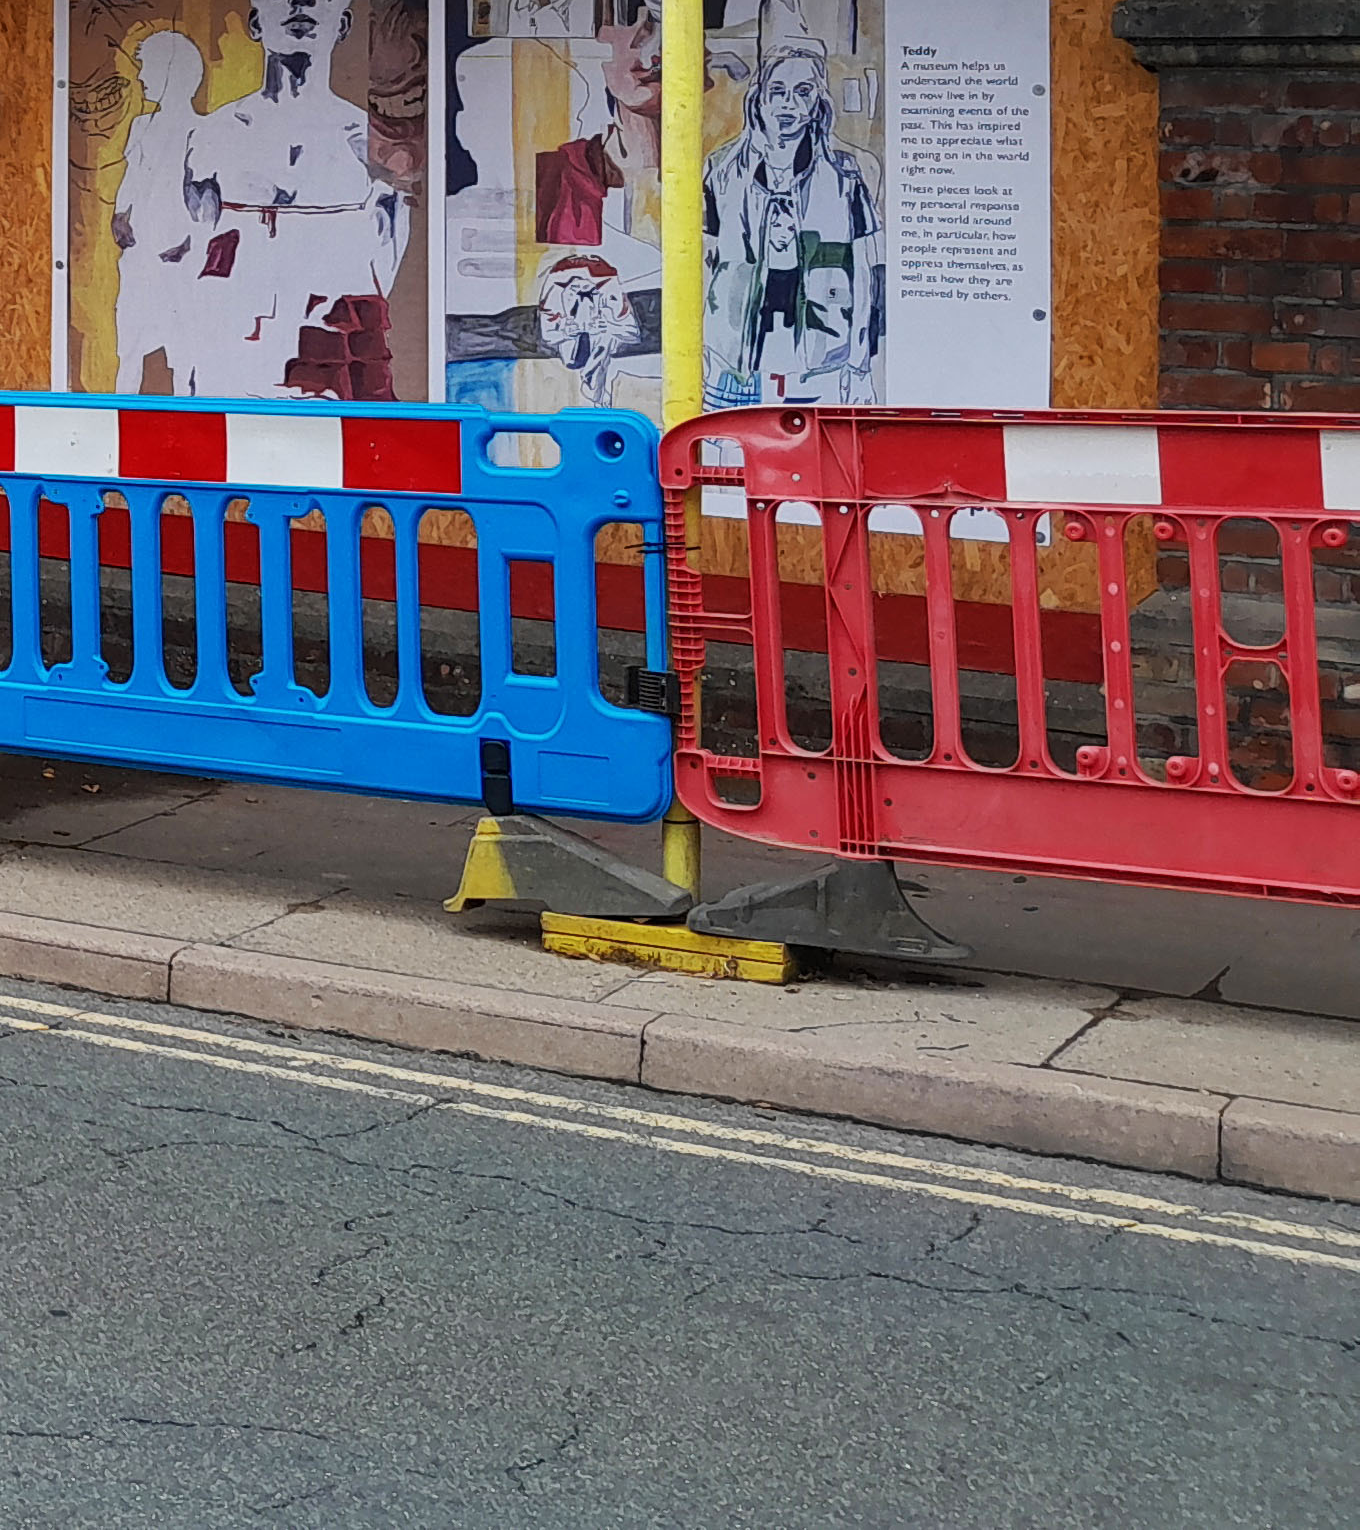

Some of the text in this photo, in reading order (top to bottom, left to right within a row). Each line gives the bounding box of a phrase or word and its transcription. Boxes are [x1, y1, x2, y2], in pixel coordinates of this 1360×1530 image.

[901, 46, 937, 58] Teddy
[901, 62, 909, 70] A
[962, 61, 990, 73] helps
[901, 76, 1018, 86] understand the world
[947, 91, 964, 100] live
[969, 91, 978, 100] in
[982, 92, 994, 103] by
[901, 106, 1029, 117] examining events of the
[930, 120, 952, 130] This
[956, 121, 973, 130] has
[978, 122, 1021, 133] inspired
[921, 136, 933, 144] to
[936, 136, 992, 147] appreciate
[996, 136, 1022, 146] what
[901, 150, 909, 159] is
[913, 151, 941, 162] going
[962, 151, 972, 160] in
[976, 152, 993, 160] the
[901, 165, 926, 176] right
[901, 183, 1012, 196] These pieces look at
[901, 201, 916, 210] my
[920, 200, 966, 210] personal
[902, 214, 1012, 226] to the world around
[924, 229, 932, 238] in
[992, 231, 1016, 240] how
[901, 244, 1016, 256] people represent and
[1012, 263, 1023, 272] as
[901, 273, 922, 282] well
[941, 274, 964, 283] how
[968, 275, 990, 287] they
[996, 278, 1012, 286] are
[901, 289, 952, 300] perceived
[957, 290, 969, 301] by
